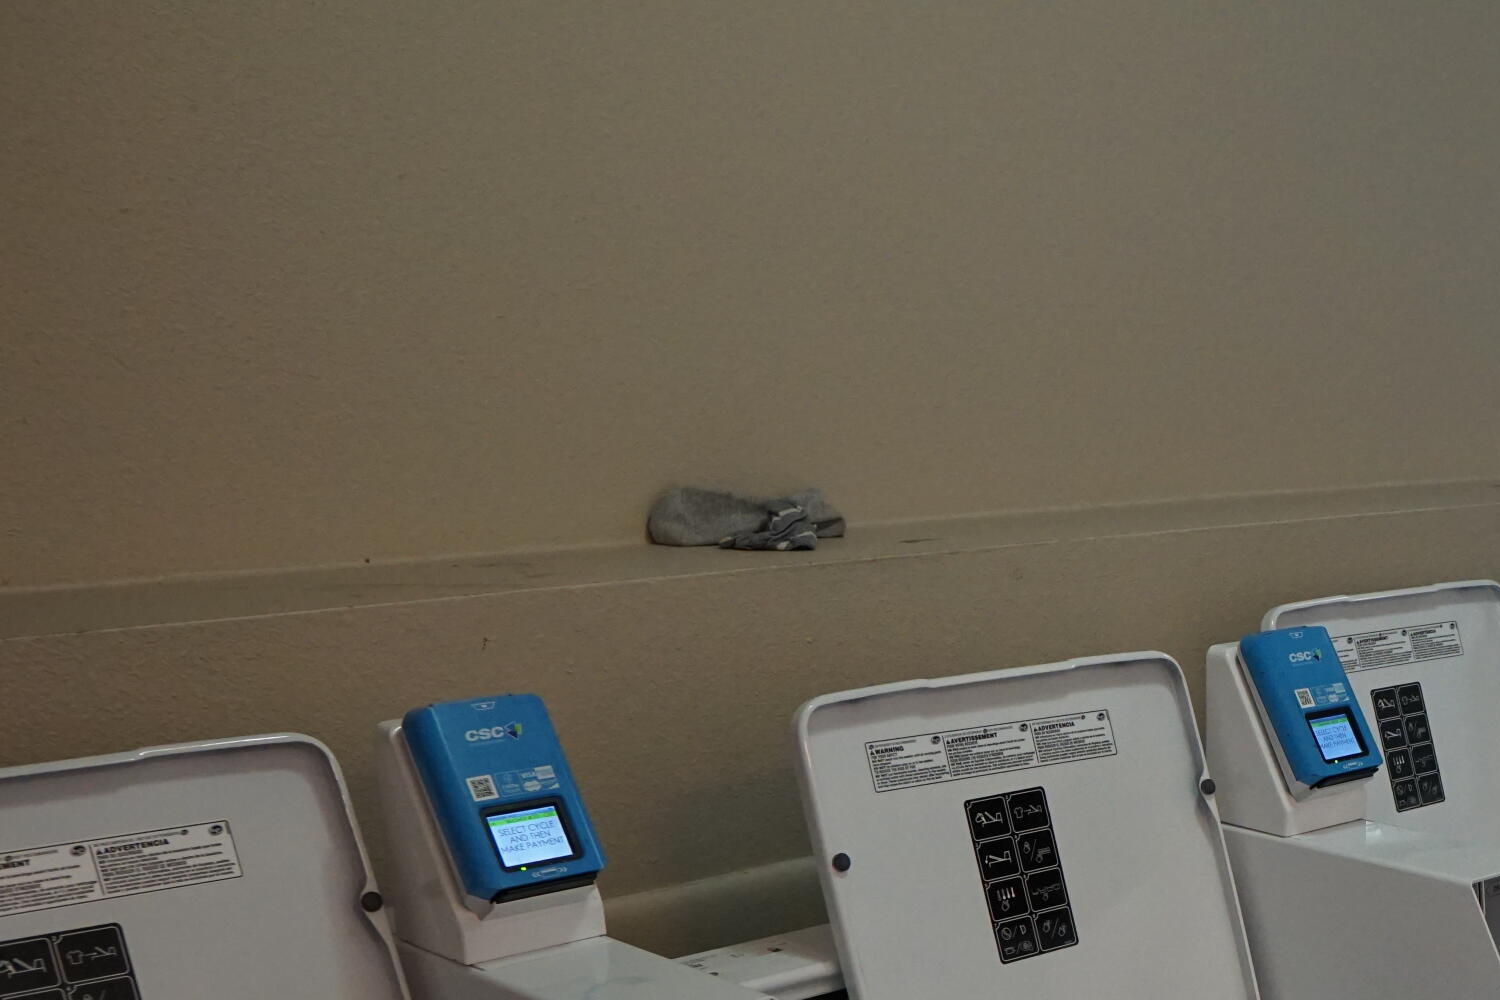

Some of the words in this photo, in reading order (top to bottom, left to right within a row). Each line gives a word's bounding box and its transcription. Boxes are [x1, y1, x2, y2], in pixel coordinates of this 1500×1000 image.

[1289, 651, 1312, 663] CSC
[1038, 721, 1075, 732] ADVERTENCIA
[465, 726, 504, 742] CSC
[951, 732, 998, 744] AVERTISSEMENT
[875, 746, 904, 755] WARNING
[499, 825, 525, 836] SELECT
[528, 821, 554, 831] CYCLE
[511, 833, 528, 844] AND
[104, 838, 169, 853] ADVERTENCIA
